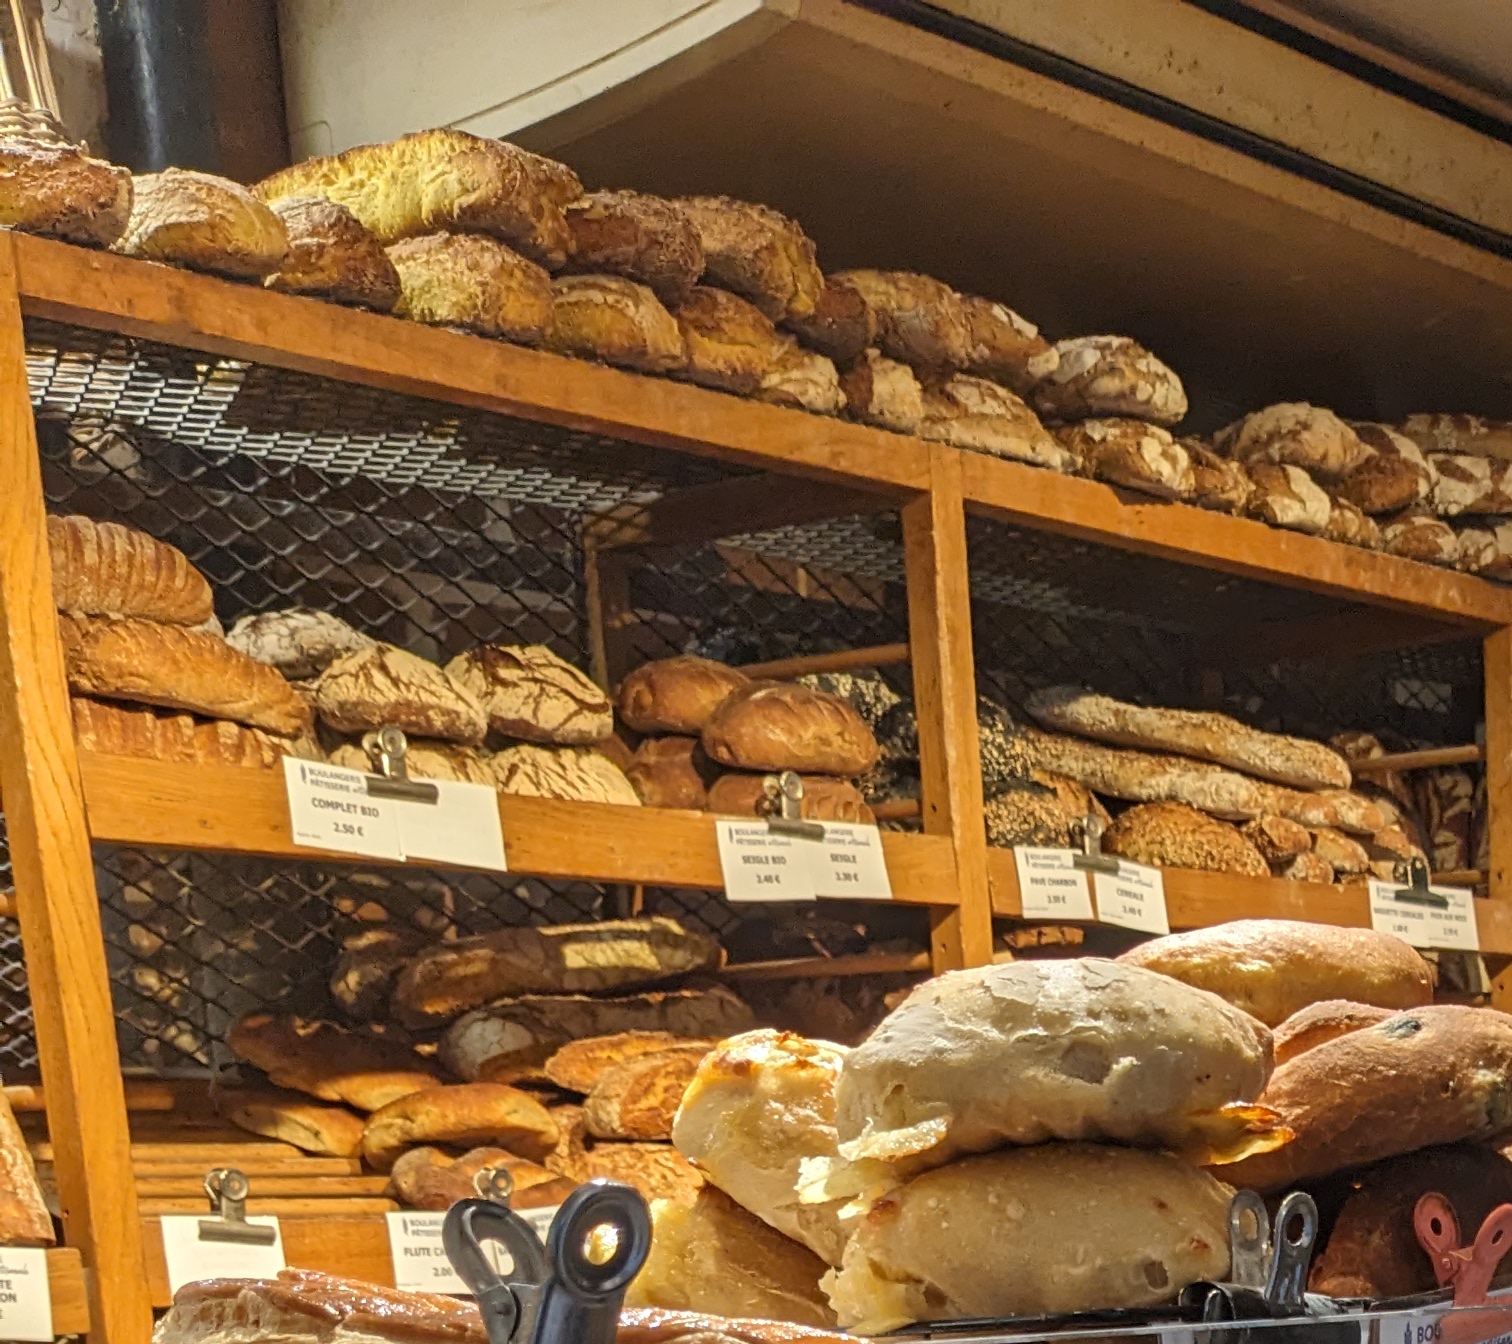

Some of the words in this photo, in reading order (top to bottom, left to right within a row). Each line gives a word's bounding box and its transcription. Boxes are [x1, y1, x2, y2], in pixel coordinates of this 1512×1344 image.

[311, 797, 358, 815] COMPLET
[360, 805, 380, 818] BIO
[403, 1247, 431, 1256] FLUTE
